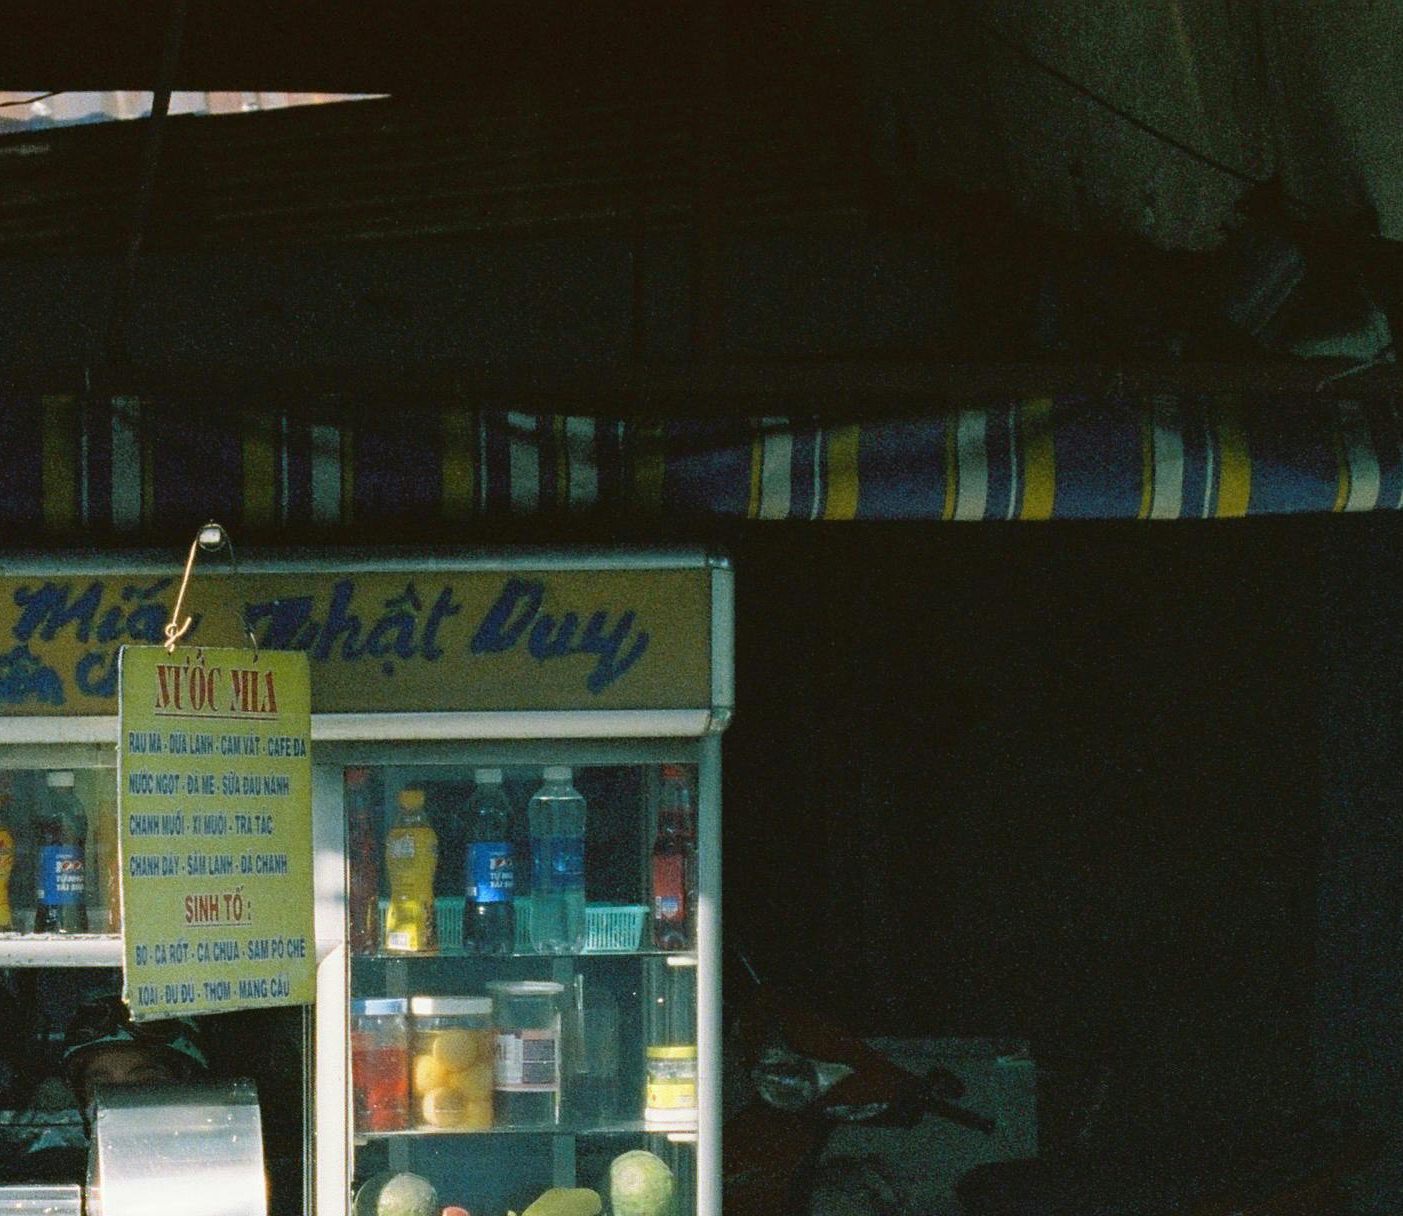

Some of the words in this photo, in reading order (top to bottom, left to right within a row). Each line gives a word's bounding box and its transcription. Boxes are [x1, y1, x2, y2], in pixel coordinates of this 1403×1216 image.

[470, 575, 650, 695] Duy
[129, 731, 147, 753] RAU
[220, 735, 241, 755] CAM
[256, 853, 288, 875] CHANH
[185, 894, 219, 924] SINH
[213, 940, 240, 961] CHUA
